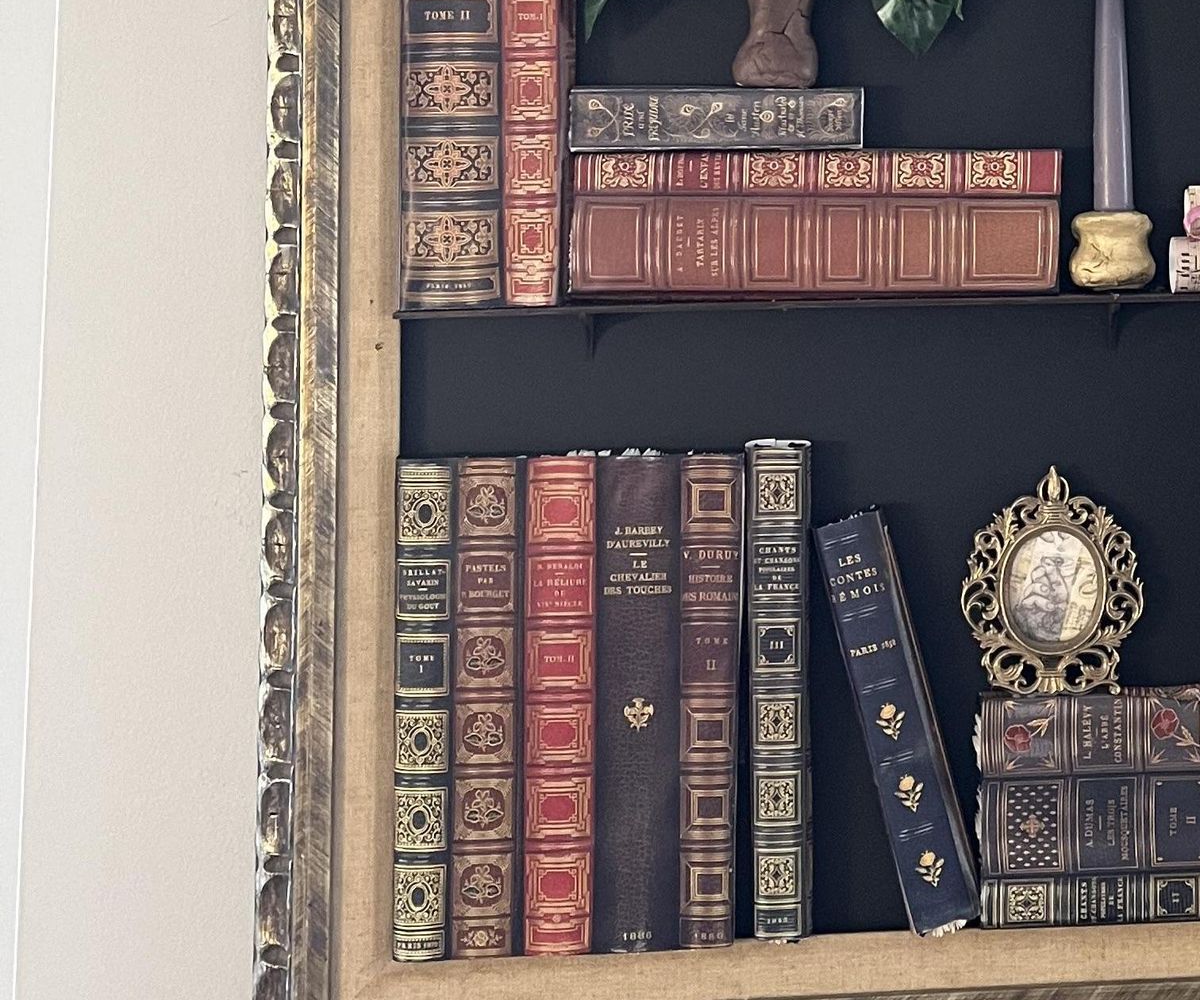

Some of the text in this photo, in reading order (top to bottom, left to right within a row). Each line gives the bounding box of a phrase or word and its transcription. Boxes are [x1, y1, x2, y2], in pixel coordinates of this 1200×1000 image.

[424, 10, 471, 20] TOME II
[710, 239, 719, 256] LES
[711, 260, 719, 277] SUR
[614, 526, 663, 536] J. BARBEY
[606, 539, 670, 549] D'AUREVILLY
[683, 550, 739, 560] V. DURUY
[758, 546, 797, 554] CHANTS
[633, 560, 648, 568] LE
[838, 553, 862, 568] LES
[465, 564, 507, 572] PASTELS
[610, 573, 667, 582] CHEVALIER
[688, 574, 733, 583] HISTOIRE
[829, 567, 878, 587] CONTES
[604, 585, 673, 595] DES TOUCHES
[696, 637, 729, 645] TOME
[769, 640, 784, 650] III
[849, 643, 878, 658] PARIS
[706, 659, 716, 670] II
[1113, 698, 1123, 764] CONSTANTIN
[1084, 798, 1094, 837] DUMAS
[1169, 806, 1178, 837] TOME
[1185, 816, 1196, 825] II
